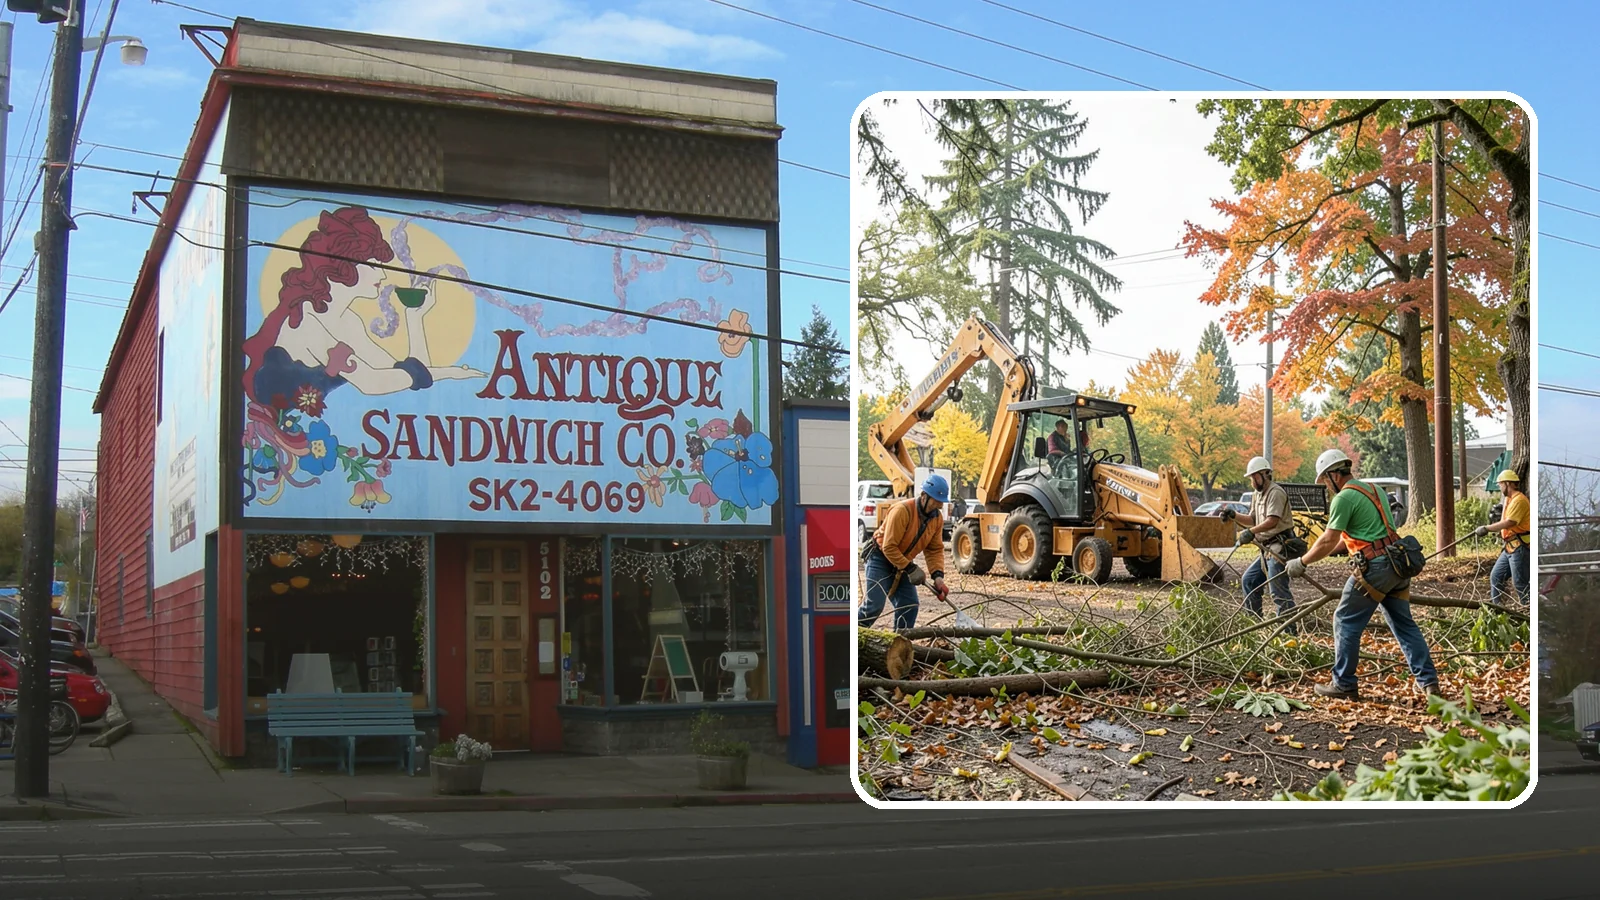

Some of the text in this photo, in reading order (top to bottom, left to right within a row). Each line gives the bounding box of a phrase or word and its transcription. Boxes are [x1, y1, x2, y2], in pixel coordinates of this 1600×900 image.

[475, 328, 723, 420] ANTIQUE
[361, 408, 685, 469] SANDWICH CO.
[469, 477, 646, 513] SK2-4069
[540, 541, 552, 600] 5102
[809, 555, 834, 568] BOOKS
